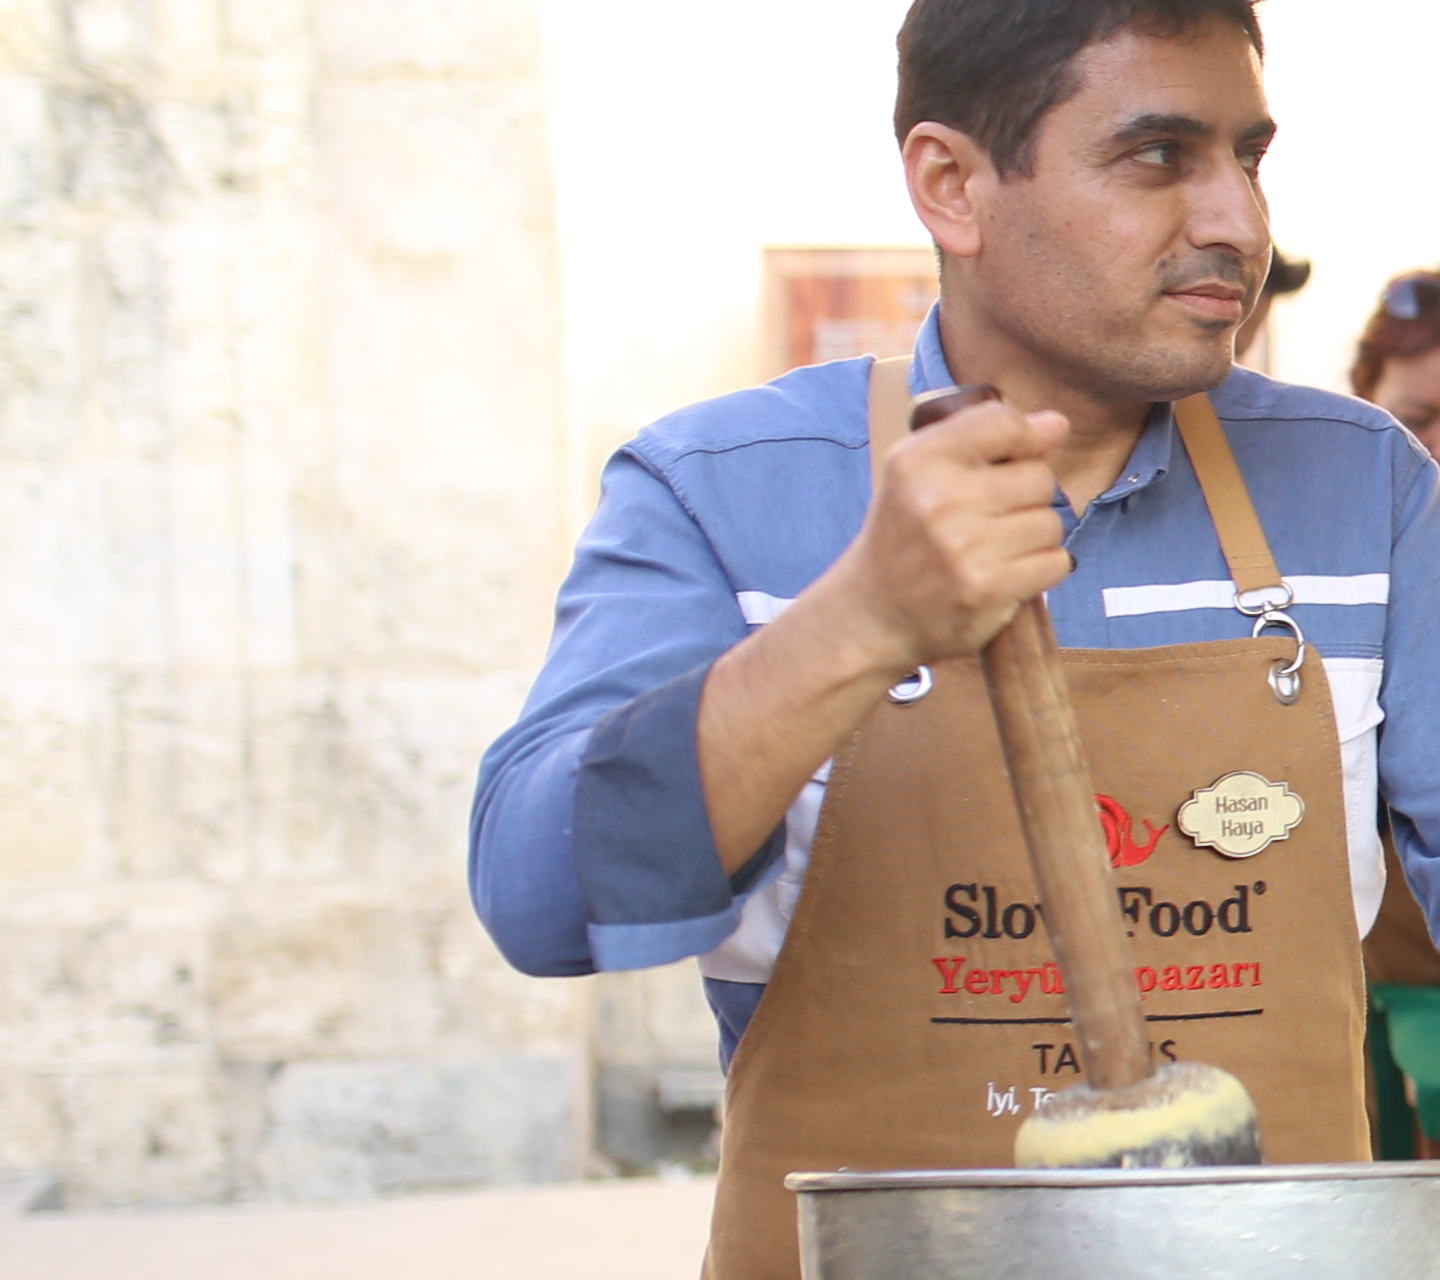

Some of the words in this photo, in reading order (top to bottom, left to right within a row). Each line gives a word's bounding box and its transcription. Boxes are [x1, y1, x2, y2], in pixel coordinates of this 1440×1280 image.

[1215, 796, 1268, 814] Hasan
[944, 883, 1043, 939] Slo
[931, 956, 1066, 1003] Yeryü
